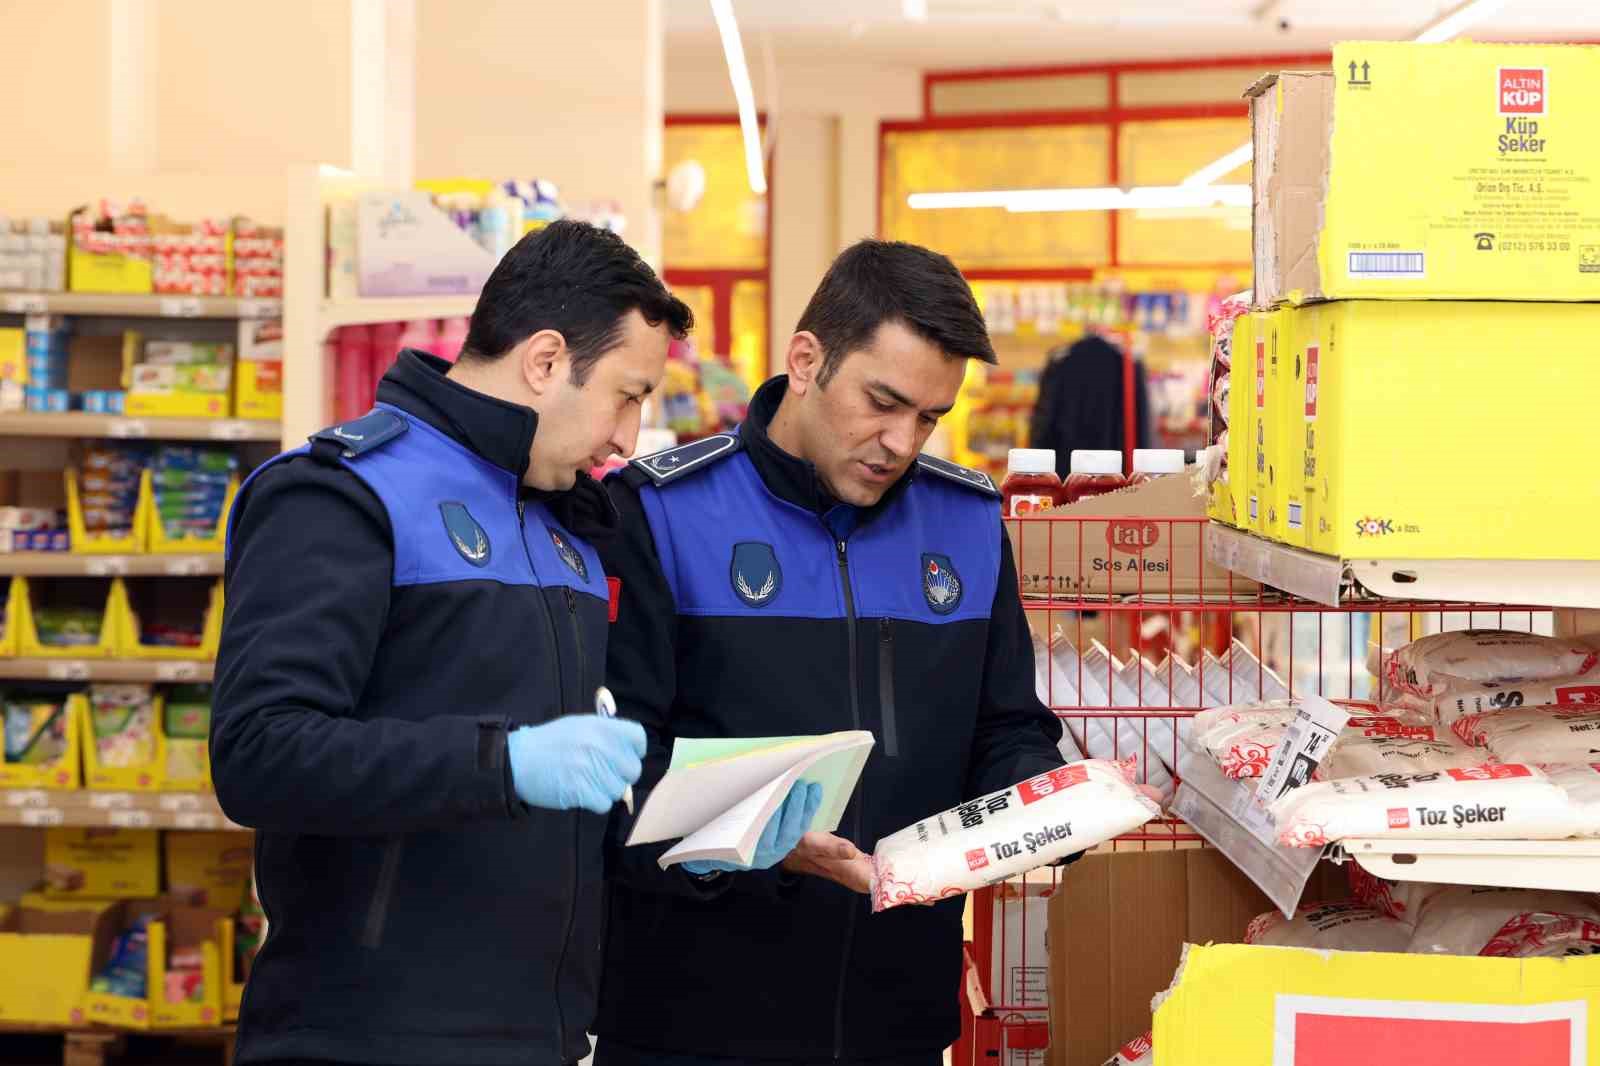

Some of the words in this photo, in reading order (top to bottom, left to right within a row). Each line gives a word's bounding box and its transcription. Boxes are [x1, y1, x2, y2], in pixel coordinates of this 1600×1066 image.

[1503, 78, 1541, 89] ALTIN
[1503, 89, 1542, 106] KÜP
[1506, 117, 1538, 138] Küp
[1498, 134, 1547, 156] Şeker
[1113, 525, 1152, 546] tat
[1092, 558, 1122, 572] Sos
[1126, 558, 1169, 572] Alesi
[1416, 807, 1448, 827] Toz
[1452, 803, 1507, 829] Şeker
[990, 840, 1022, 861] Toz
[1022, 821, 1073, 855] Şeker
